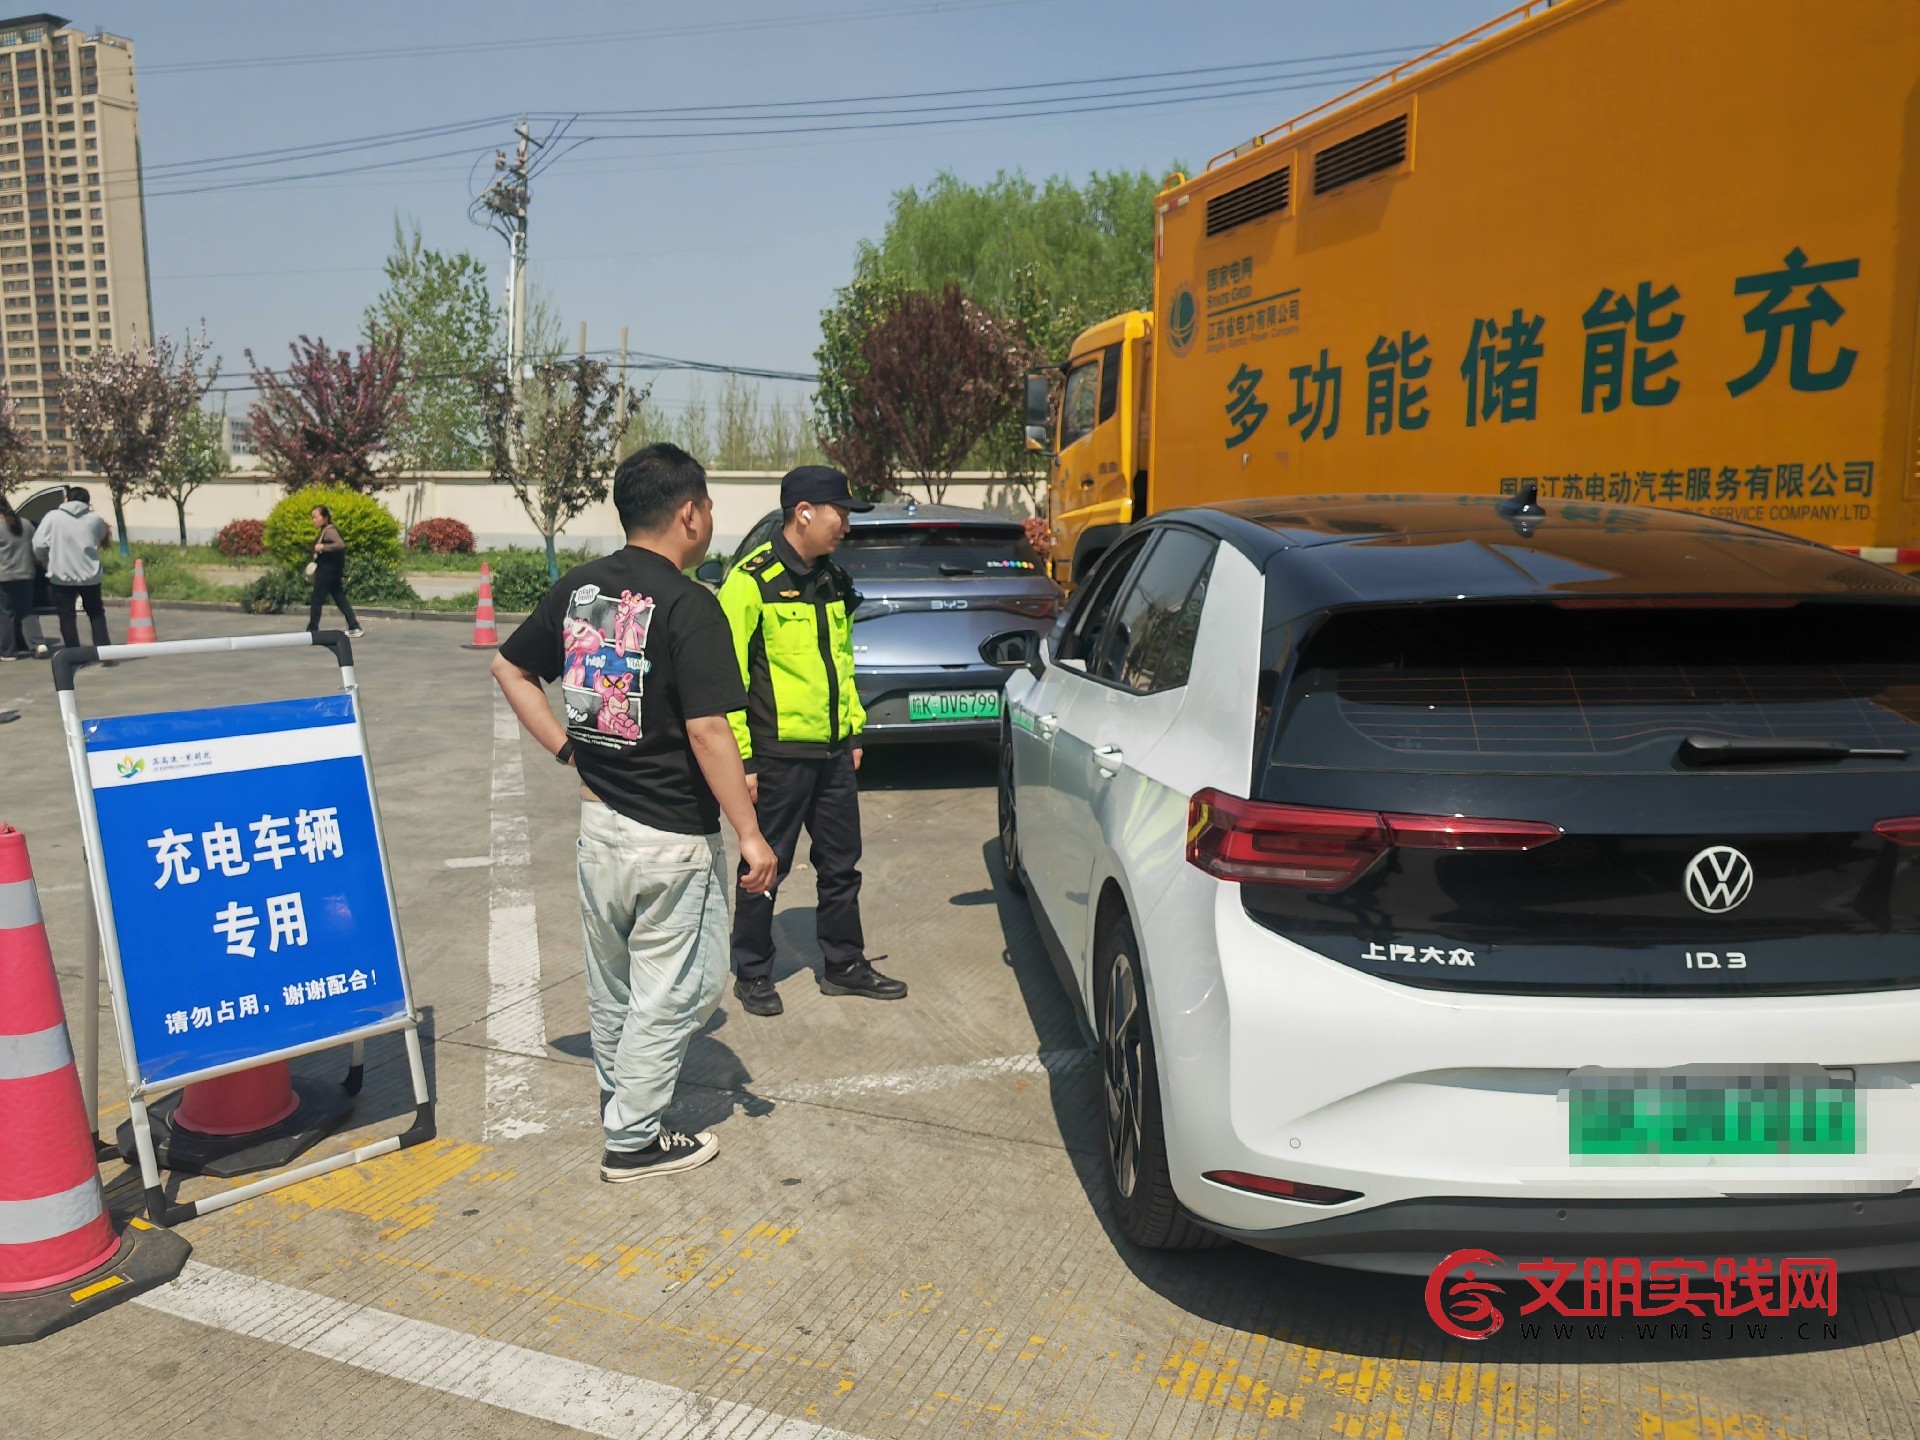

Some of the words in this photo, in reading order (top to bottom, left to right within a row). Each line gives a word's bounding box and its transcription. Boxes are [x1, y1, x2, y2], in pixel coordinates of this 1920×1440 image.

[1207, 256, 1253, 291] 国家电网
[1207, 299, 1299, 342] 江苏省电力有限公司
[1225, 246, 1861, 449] 多功能储能充
[1709, 504, 1764, 521] SERVICE
[931, 600, 968, 610] BYD
[940, 694, 996, 714] DV6799
[146, 806, 344, 889] 充电车辆
[213, 892, 309, 958] 专用
[1361, 942, 1476, 967] 上汽大众
